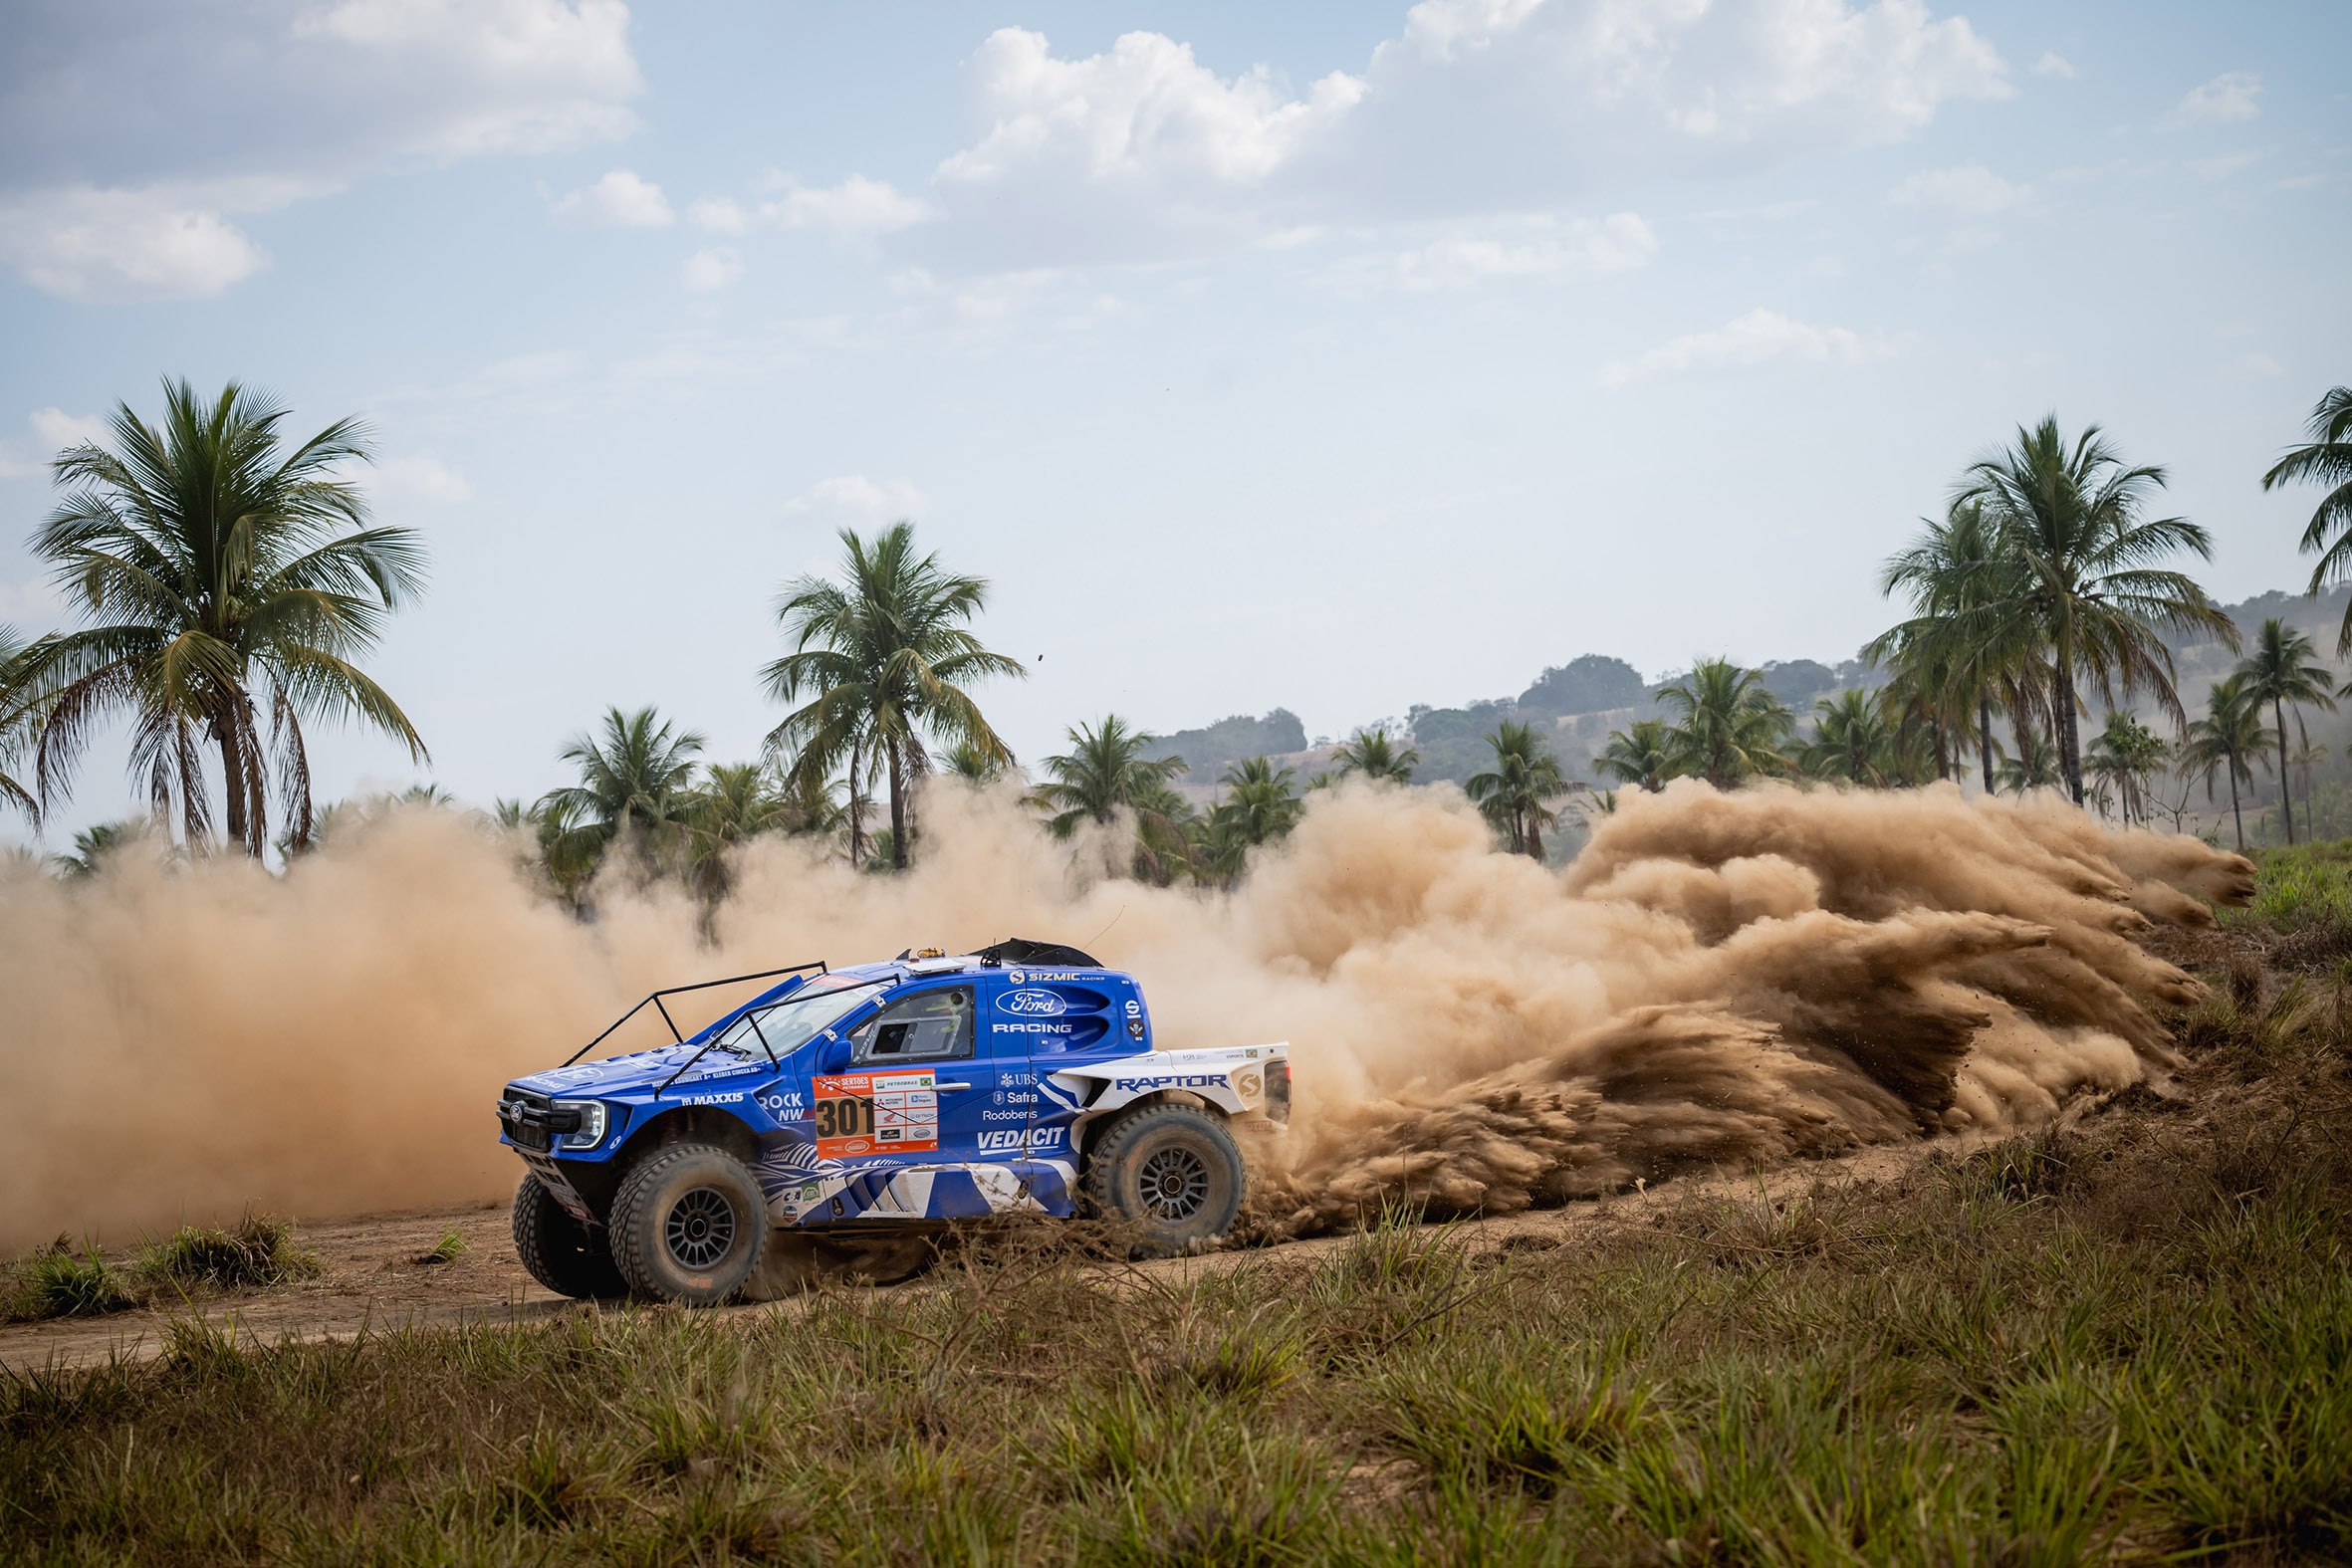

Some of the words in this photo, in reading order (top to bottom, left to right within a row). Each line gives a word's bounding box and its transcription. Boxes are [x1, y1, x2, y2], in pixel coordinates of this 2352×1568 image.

[1029, 973, 1080, 982] SIZMIC
[1011, 992, 1056, 1012] Ford
[992, 1023, 1072, 1033] RACING
[1016, 1073, 1038, 1085] UBS
[1116, 1074, 1231, 1094] RAPTOR
[694, 1092, 744, 1105] MAXXIS
[759, 1092, 804, 1110] ROCK
[1007, 1091, 1038, 1103] Safra
[817, 1098, 875, 1137] 301
[983, 1110, 1038, 1121] Rodobens
[977, 1127, 1065, 1149] VEDACIT
